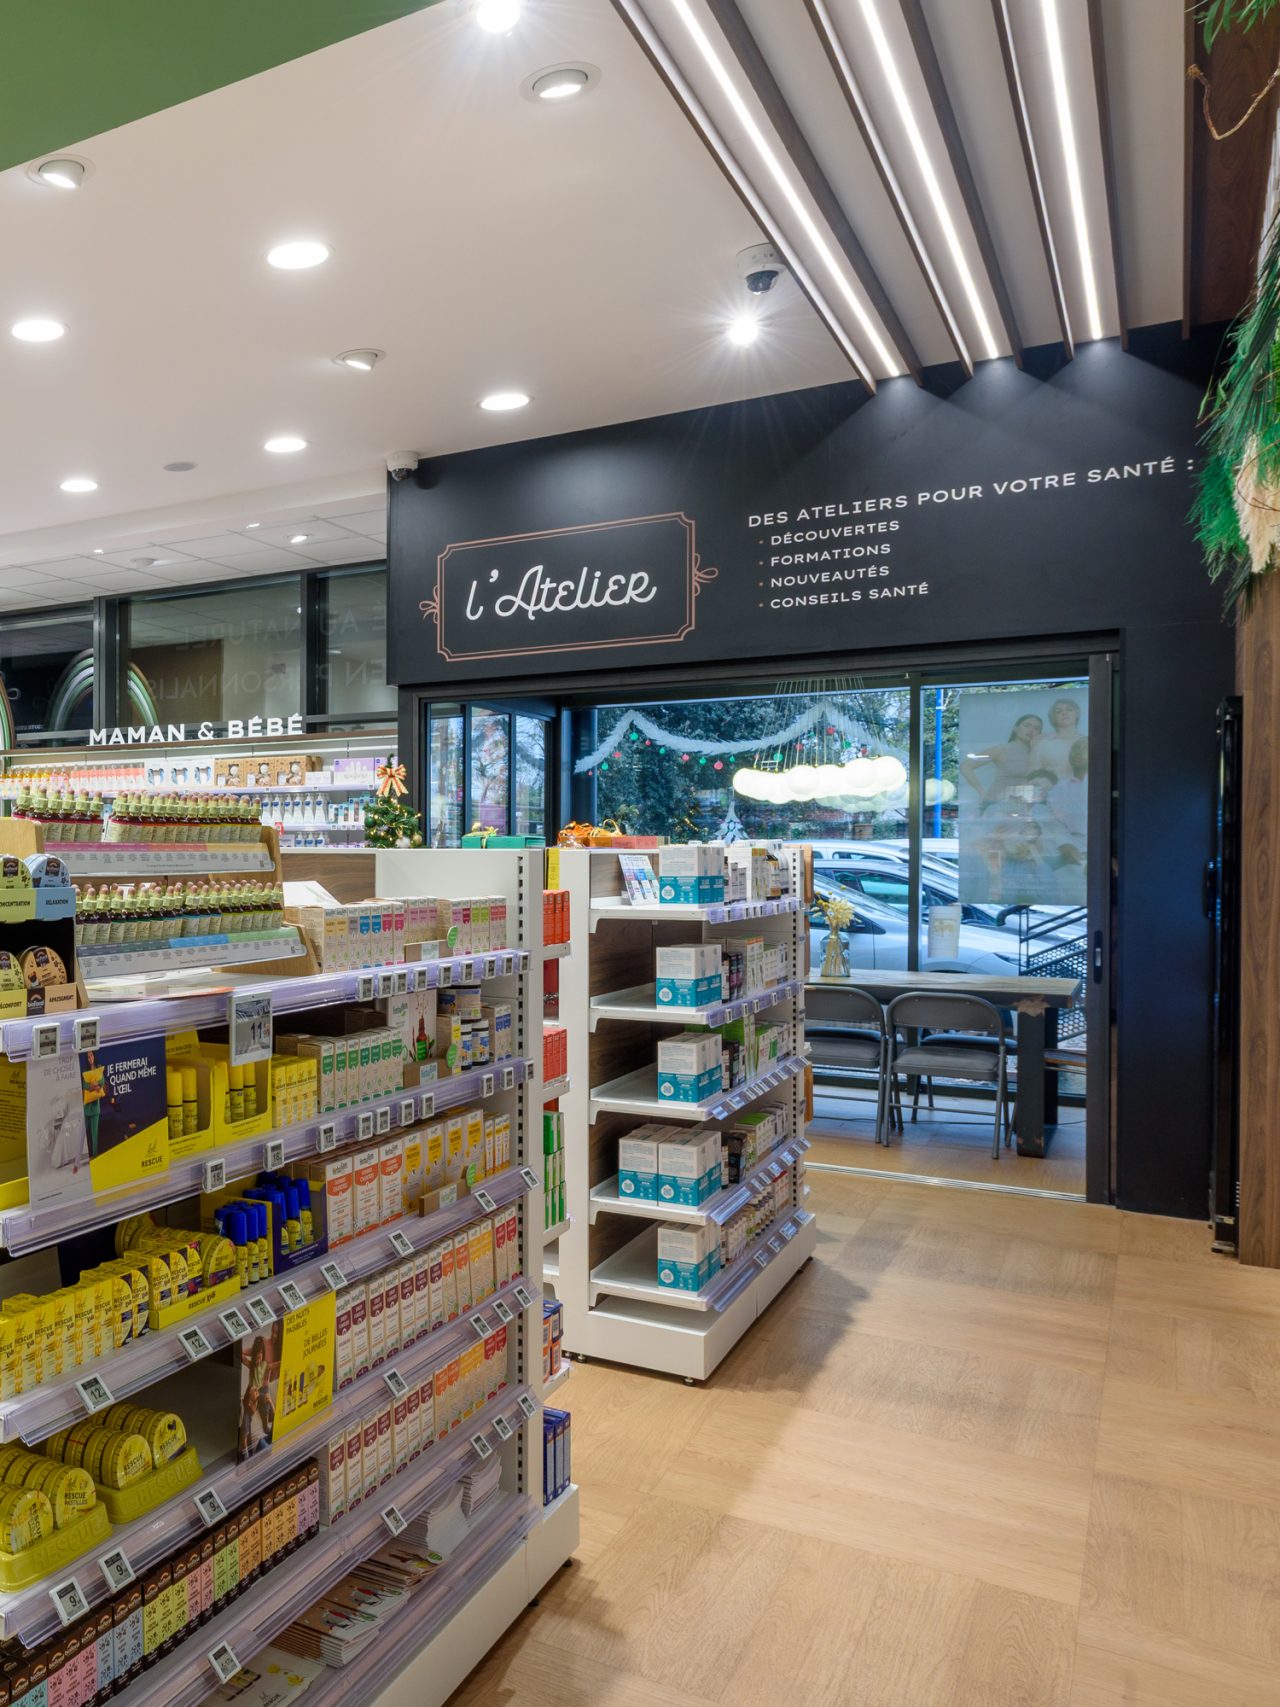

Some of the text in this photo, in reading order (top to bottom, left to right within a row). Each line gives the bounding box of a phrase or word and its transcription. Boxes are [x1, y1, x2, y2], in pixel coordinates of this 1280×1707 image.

[748, 511, 788, 528] DES
[796, 495, 908, 522] ATELIERS
[918, 485, 983, 505] POUR
[993, 472, 1076, 495] VOTRE
[1087, 456, 1175, 482] SANTÉ
[771, 520, 900, 546] DÉCOUVERTES
[771, 543, 891, 567] FORMATIONS
[771, 565, 890, 588] NOUVEAUTÉS
[770, 581, 929, 609] CONSEILS SANTÉ
[89, 713, 304, 746] MAMAN & BÉBÉ
[107, 1056, 148, 1076] JE FERMERAI
[110, 1065, 157, 1085] QUAND MÊME
[141, 1155, 163, 1168] RESCUE
[191, 1337, 202, 1349] 12
[90, 1387, 103, 1400] 12
[64, 1492, 86, 1500] RESCUE
